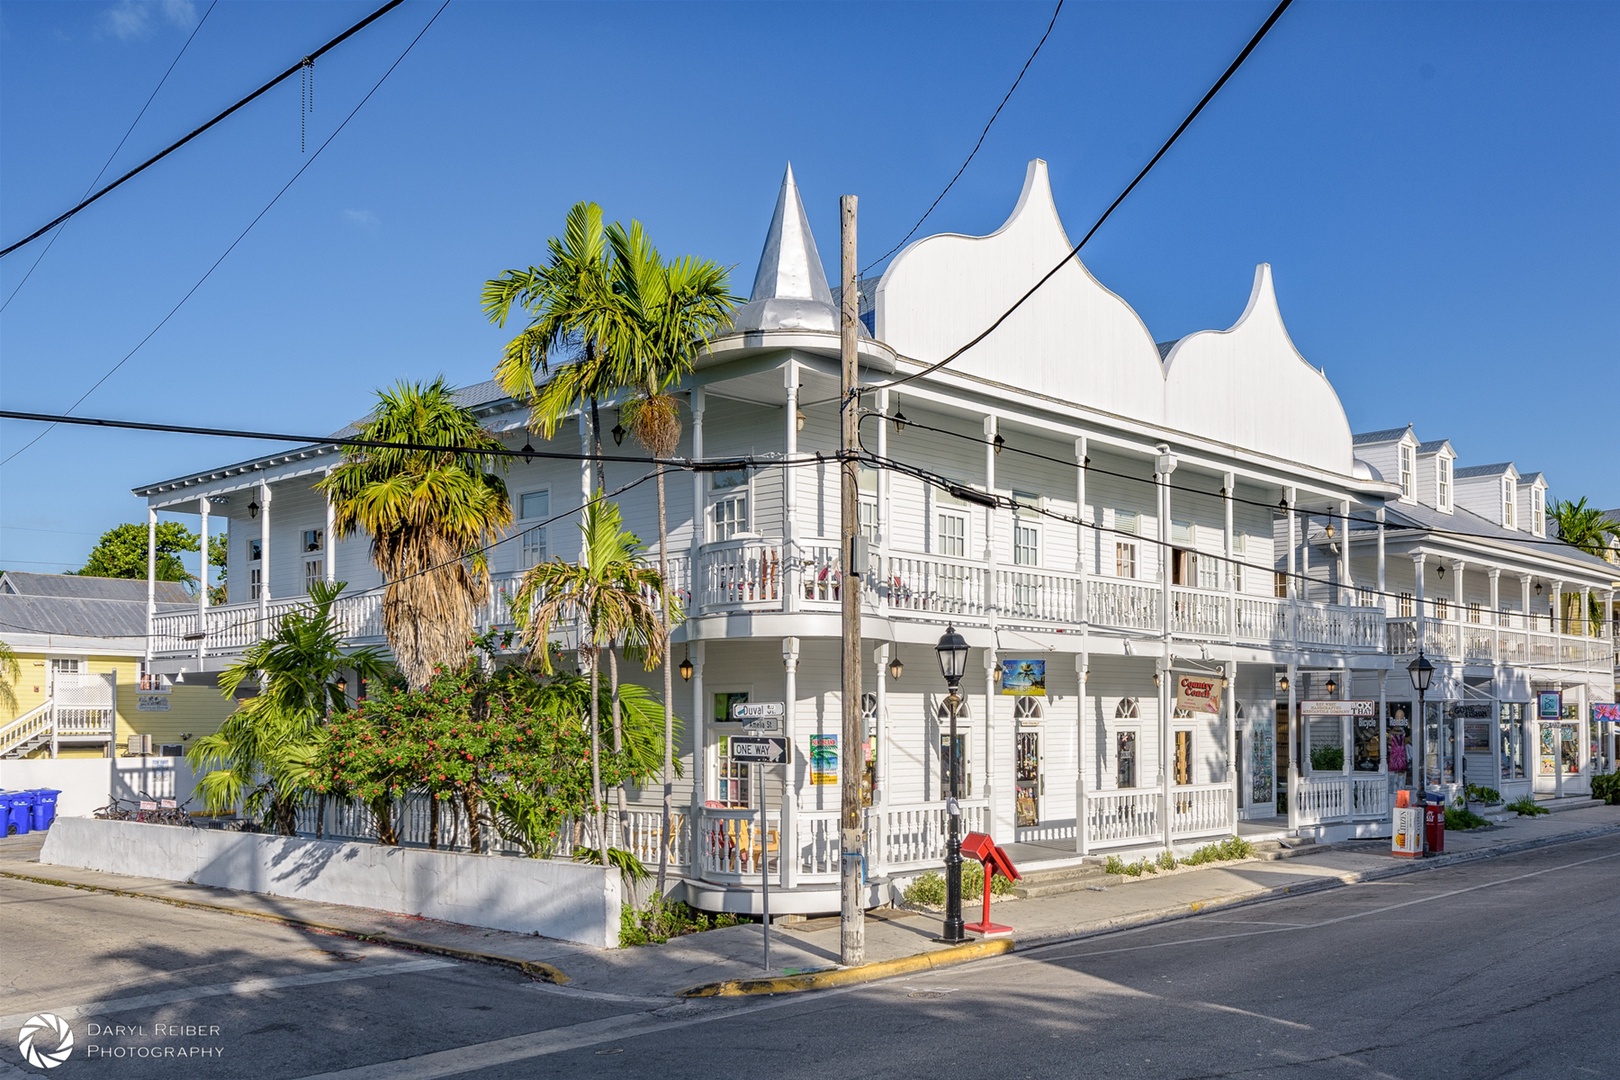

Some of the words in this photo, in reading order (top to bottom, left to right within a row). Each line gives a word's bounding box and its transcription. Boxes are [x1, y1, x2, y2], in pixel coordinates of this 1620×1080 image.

[1181, 678, 1214, 691] Country
[1185, 688, 1210, 698] Conch
[743, 705, 764, 716] Duval
[1454, 705, 1475, 714] GONE
[1358, 717, 1376, 729] Bicycle
[736, 744, 752, 755] ONE
[755, 744, 770, 755] WAY
